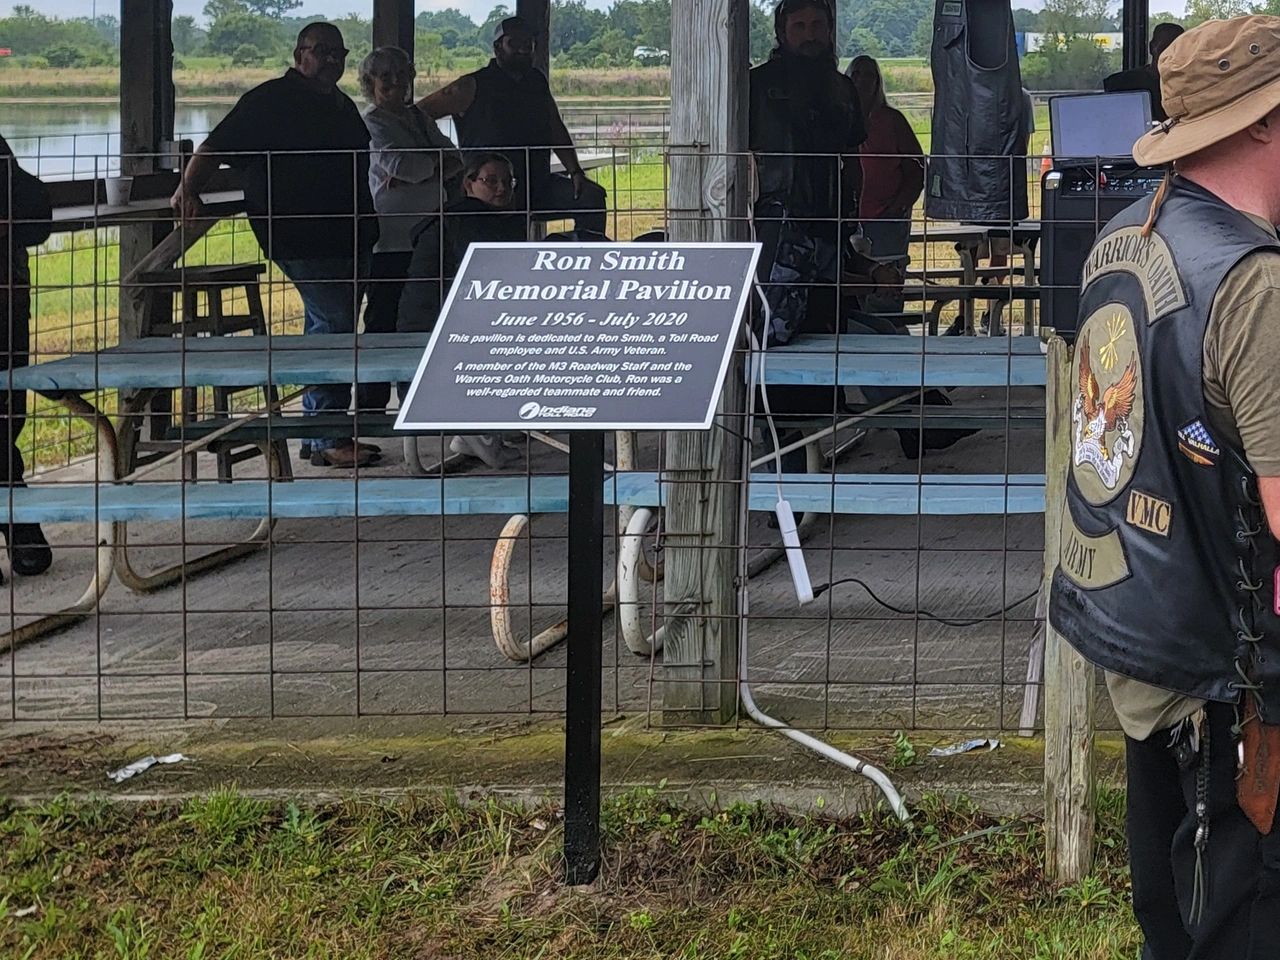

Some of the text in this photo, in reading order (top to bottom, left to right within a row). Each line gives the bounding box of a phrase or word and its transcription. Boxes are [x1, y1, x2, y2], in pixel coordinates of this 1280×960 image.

[531, 250, 686, 271] Ron Smith
[464, 279, 732, 300] Memorial Pavilion
[491, 312, 538, 326] June
[540, 312, 586, 326] 1956
[599, 312, 640, 329] July
[642, 312, 688, 326] 2020
[448, 333, 719, 344] This pavilion is dedicated to Ron Smith, a Toll Road
[489, 345, 667, 357] employee and U.S. Army Veteran.
[453, 361, 693, 373] A member of the M3 Roadway Staff and the
[454, 374, 683, 386] Warriors Oath Motorcycle Club, Ron was a
[466, 386, 662, 398] well-regarded teammate and friend.
[540, 405, 598, 414] Indiana
[1130, 492, 1170, 533] VMC
[1063, 530, 1097, 580] ARMY
